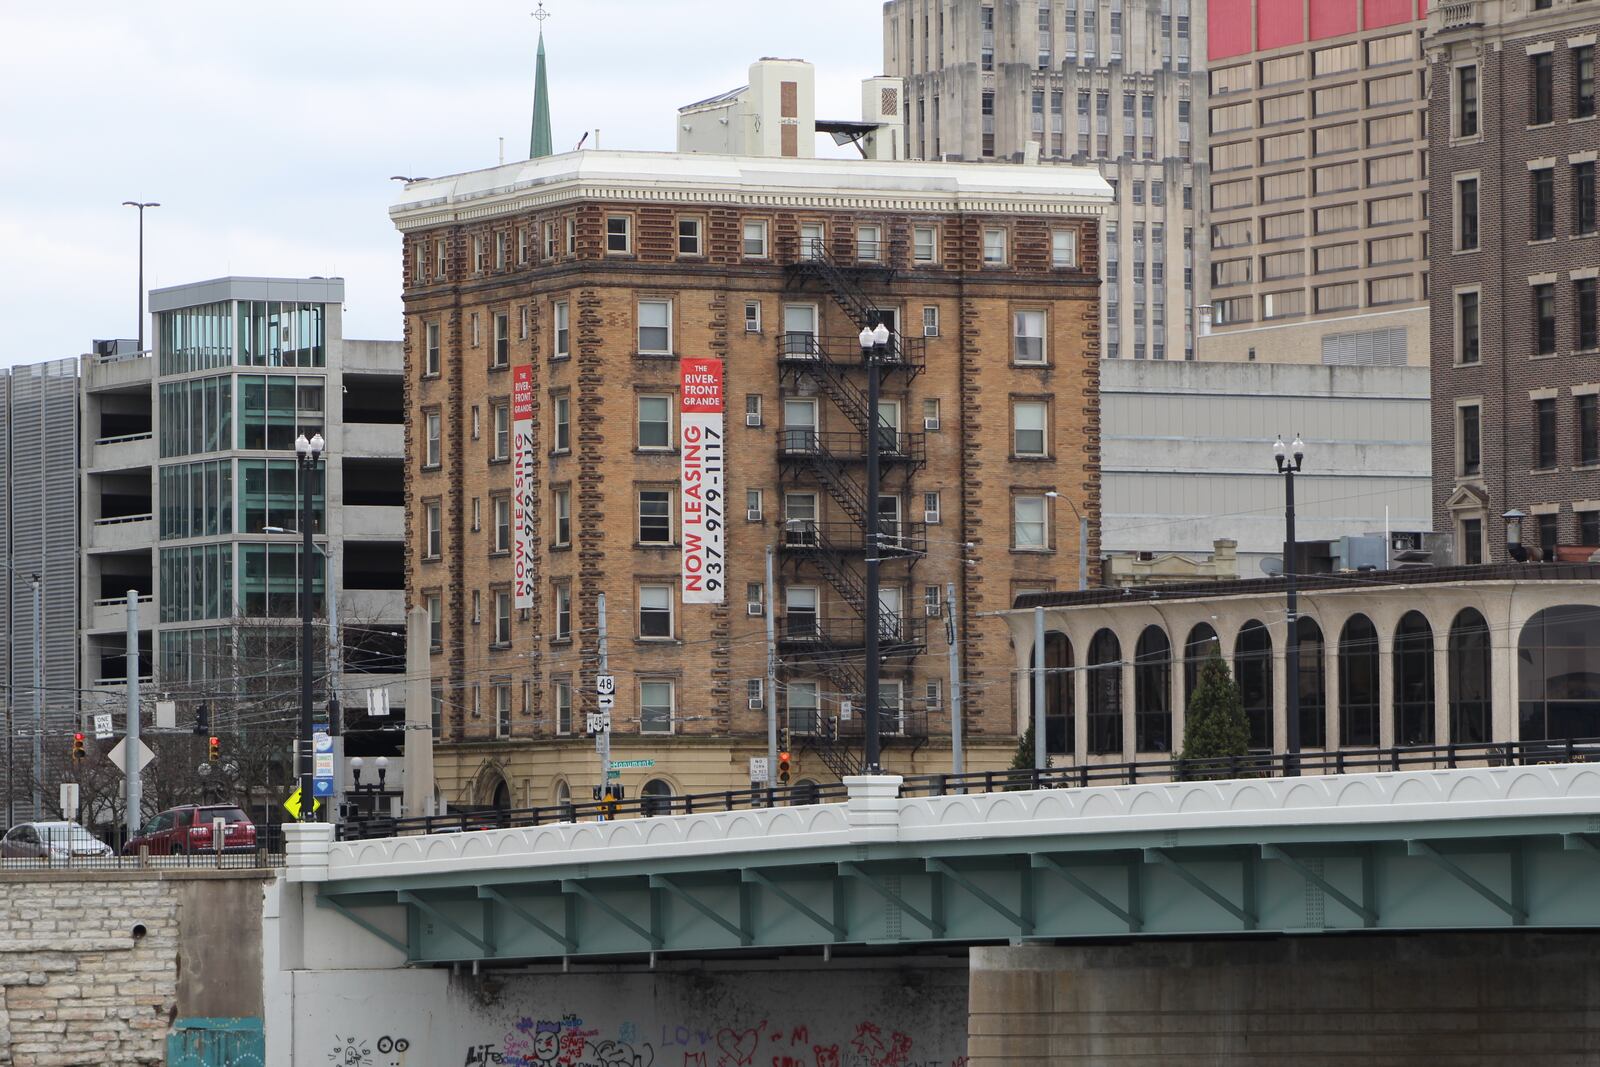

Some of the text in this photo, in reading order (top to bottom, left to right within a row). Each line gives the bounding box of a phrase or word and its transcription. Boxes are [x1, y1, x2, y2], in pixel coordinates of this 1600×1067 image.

[685, 374, 718, 384] RIVER-
[515, 381, 531, 391] RIVER-
[684, 385, 719, 395] FRONT
[515, 392, 531, 402] FRONT
[683, 397, 720, 406] GRANDE
[514, 404, 532, 414] GRANDE
[684, 425, 702, 592] NOW LEASING
[705, 426, 722, 592] 937-979-1117
[515, 432, 525, 598] NOW LEASING
[524, 433, 534, 596] 937-979-1117
[599, 678, 612, 690] 48
[97, 715, 109, 723] ONE
[97, 722, 110, 730] WAY
[613, 760, 650, 769] Monument
